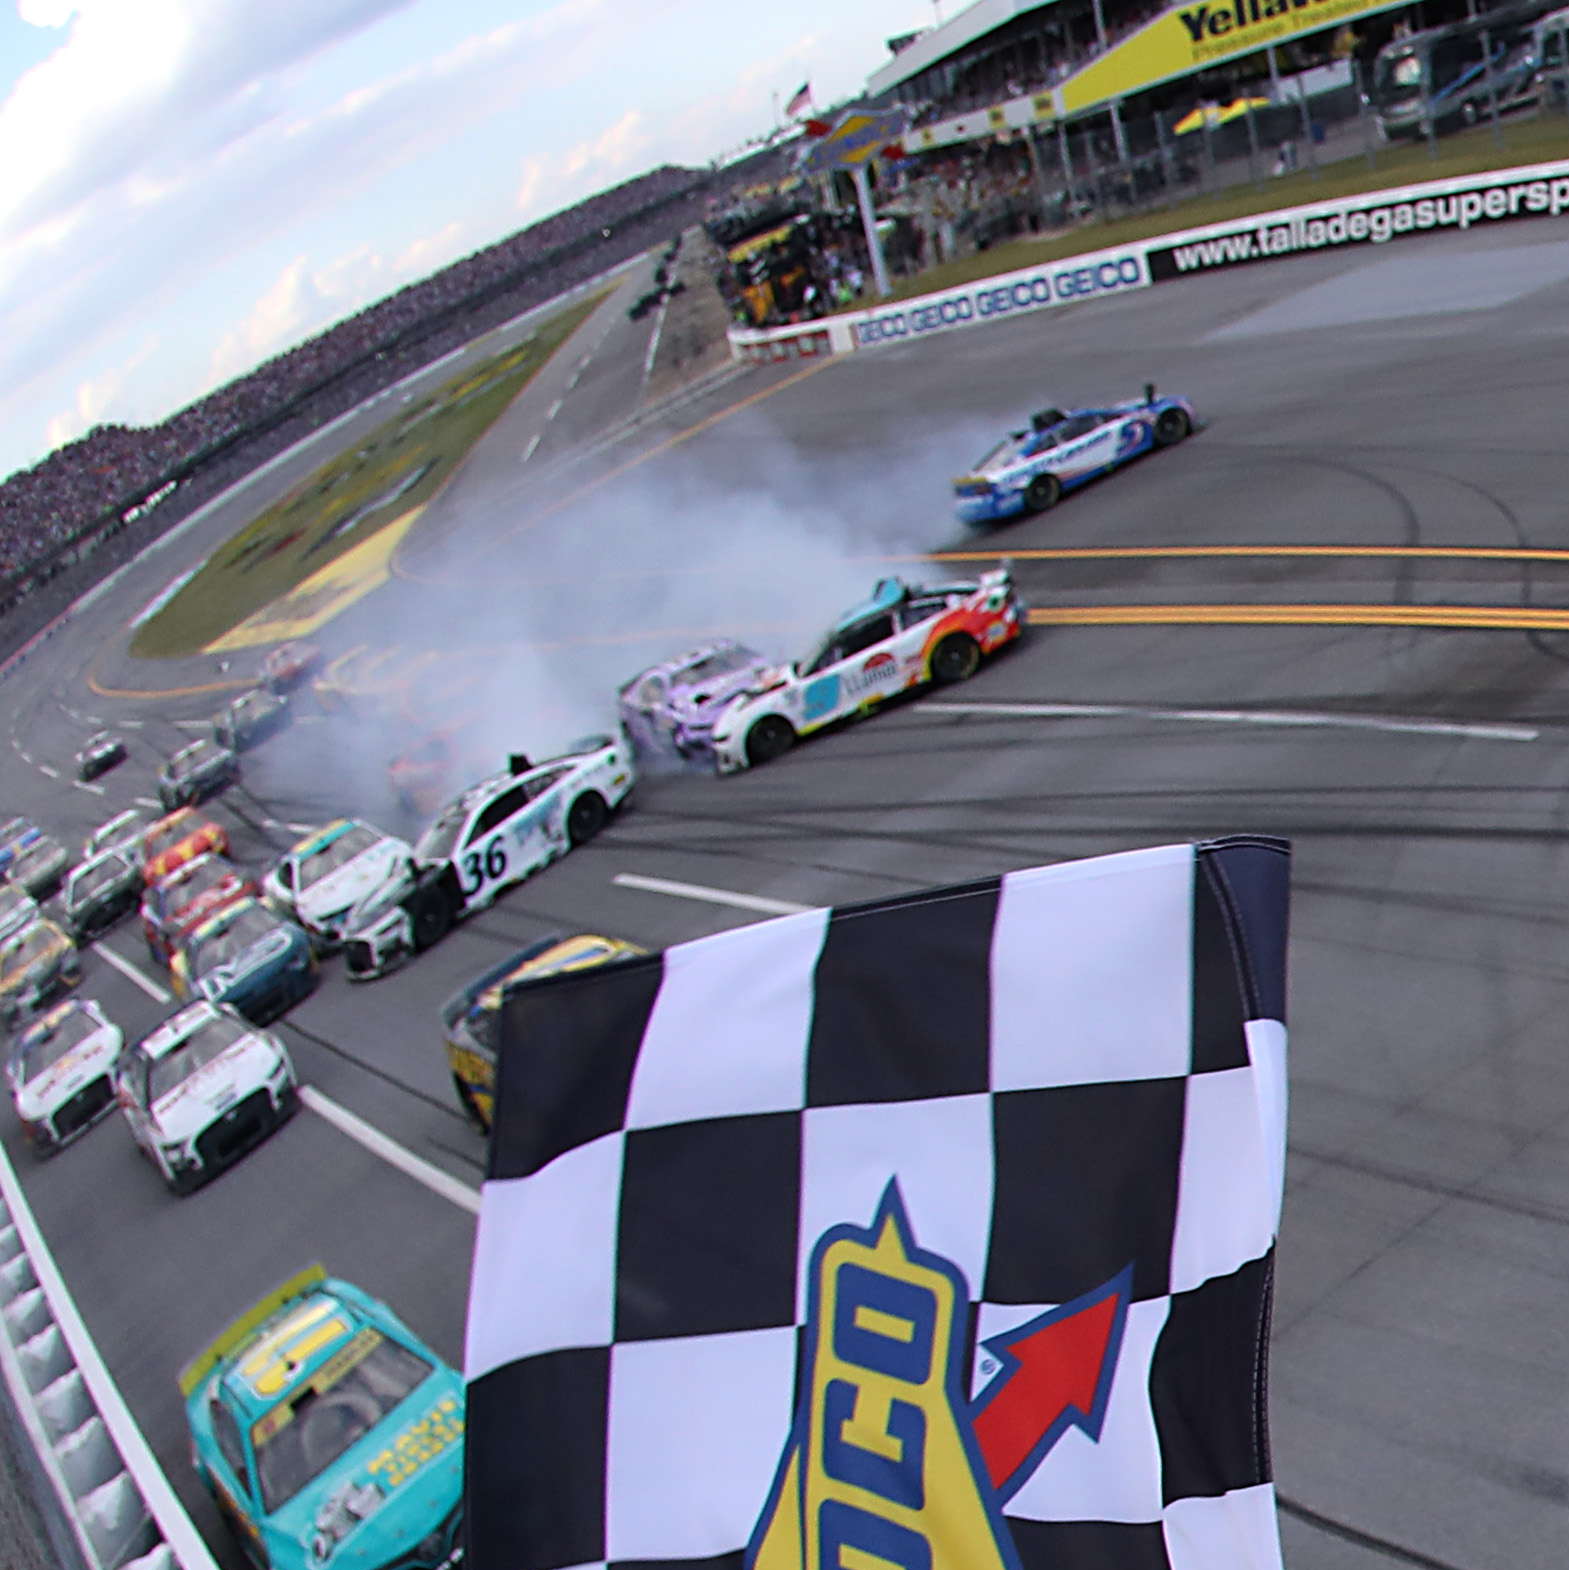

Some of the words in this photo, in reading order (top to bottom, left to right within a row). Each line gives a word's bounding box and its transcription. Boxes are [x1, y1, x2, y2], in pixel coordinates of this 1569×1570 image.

[978, 277, 1050, 316] GEICO
[1056, 257, 1141, 299] GEICO
[913, 297, 974, 333] GEICO
[460, 834, 507, 897] 36
